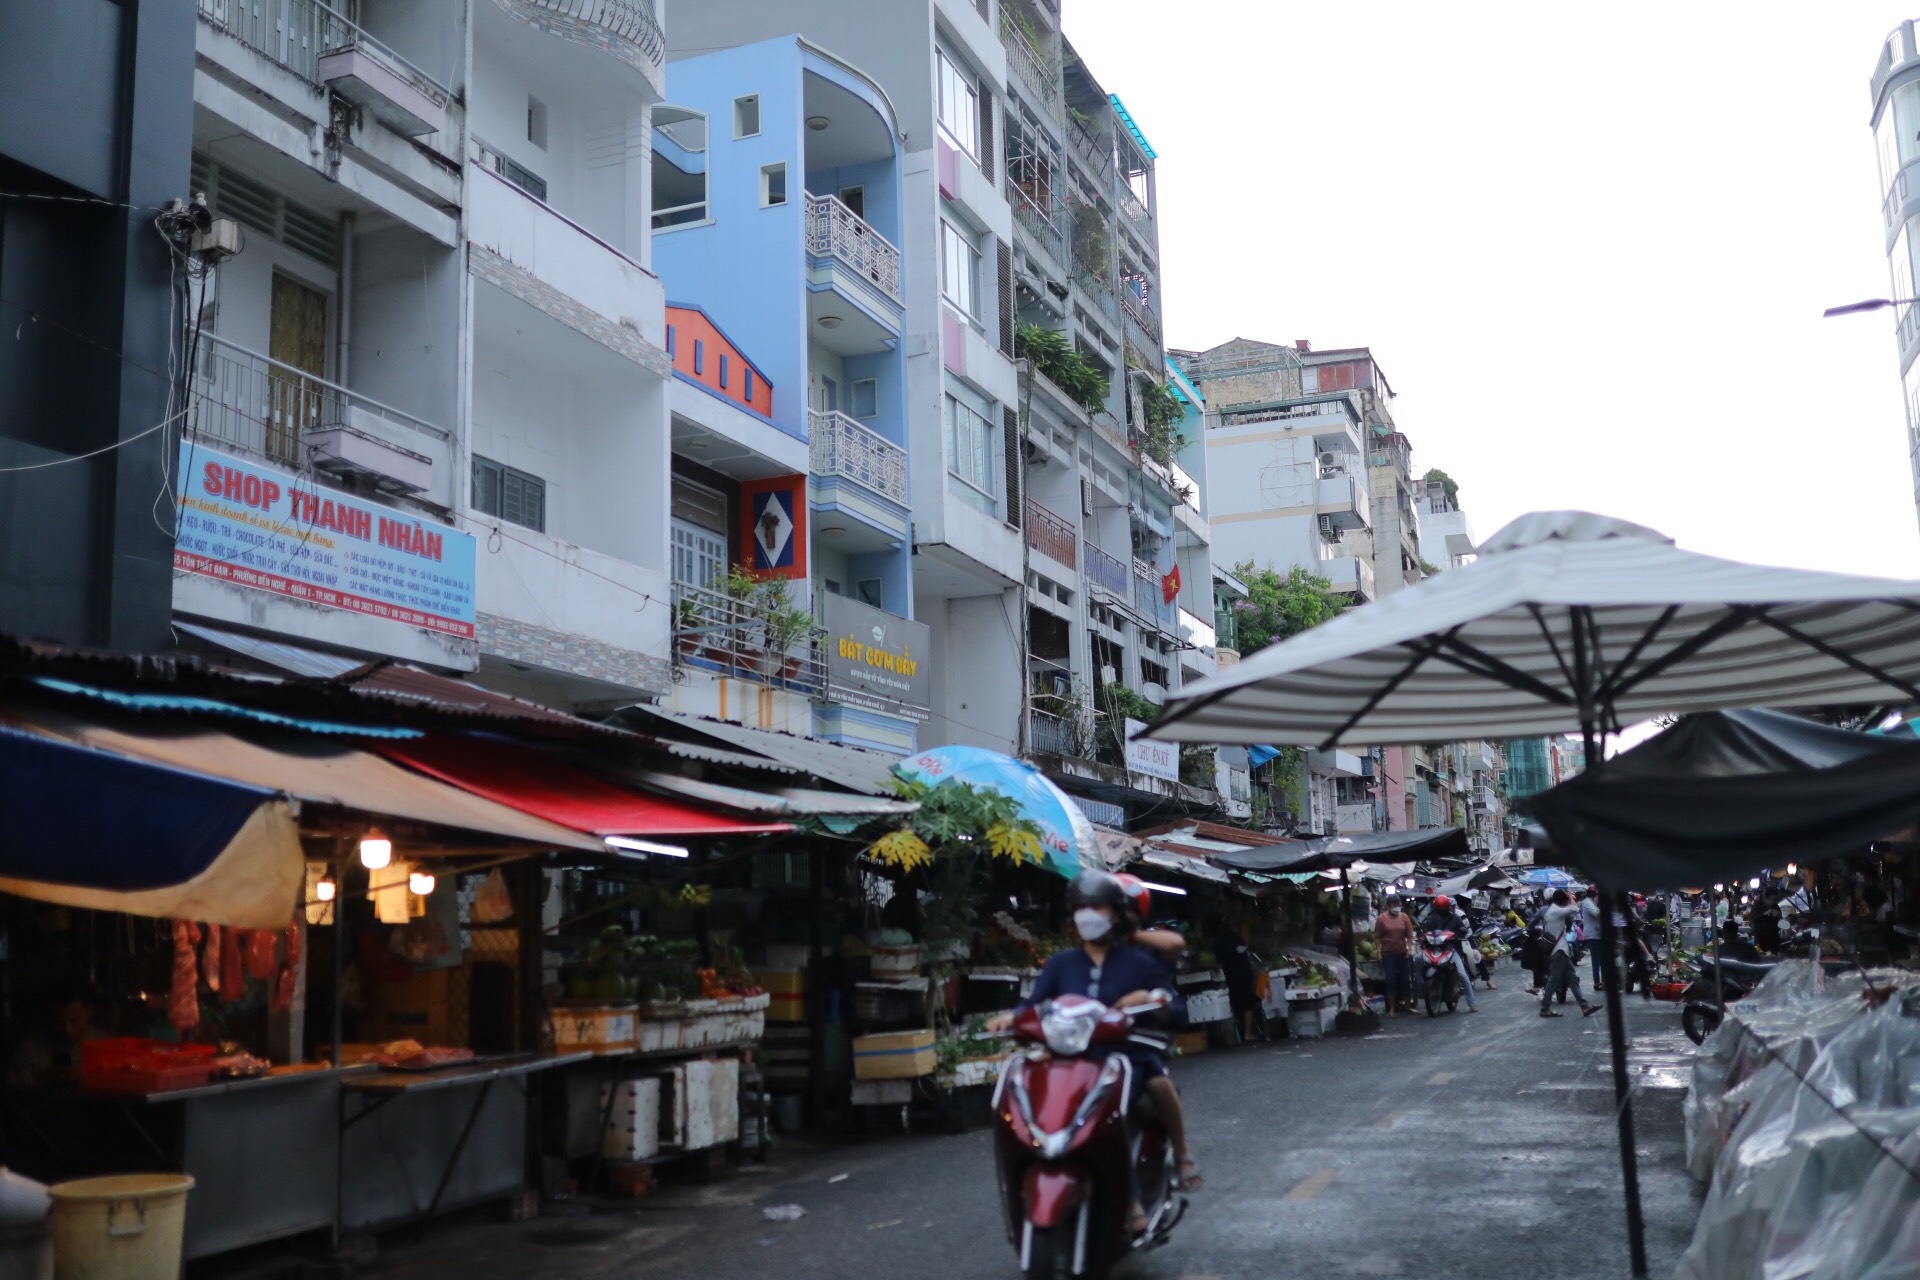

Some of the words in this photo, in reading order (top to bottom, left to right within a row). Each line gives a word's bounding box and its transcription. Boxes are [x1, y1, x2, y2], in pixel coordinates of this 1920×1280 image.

[199, 499, 218, 512] kinh
[221, 506, 247, 521] doanh
[203, 461, 280, 511] SHOP
[288, 487, 372, 541] THANH
[235, 528, 264, 546] CHOCOLATE
[181, 554, 194, 568] TÔN
[196, 557, 214, 573] THẤT
[213, 564, 228, 578] ĐẠM
[232, 568, 256, 583] PHƯỜNG
[257, 573, 269, 587] BẾN
[270, 576, 286, 590] NGHÉ
[290, 582, 305, 597] QUẬN
[315, 590, 336, 603] TP.HCM
[838, 633, 863, 662] BÁT
[865, 646, 894, 672] CƠM
